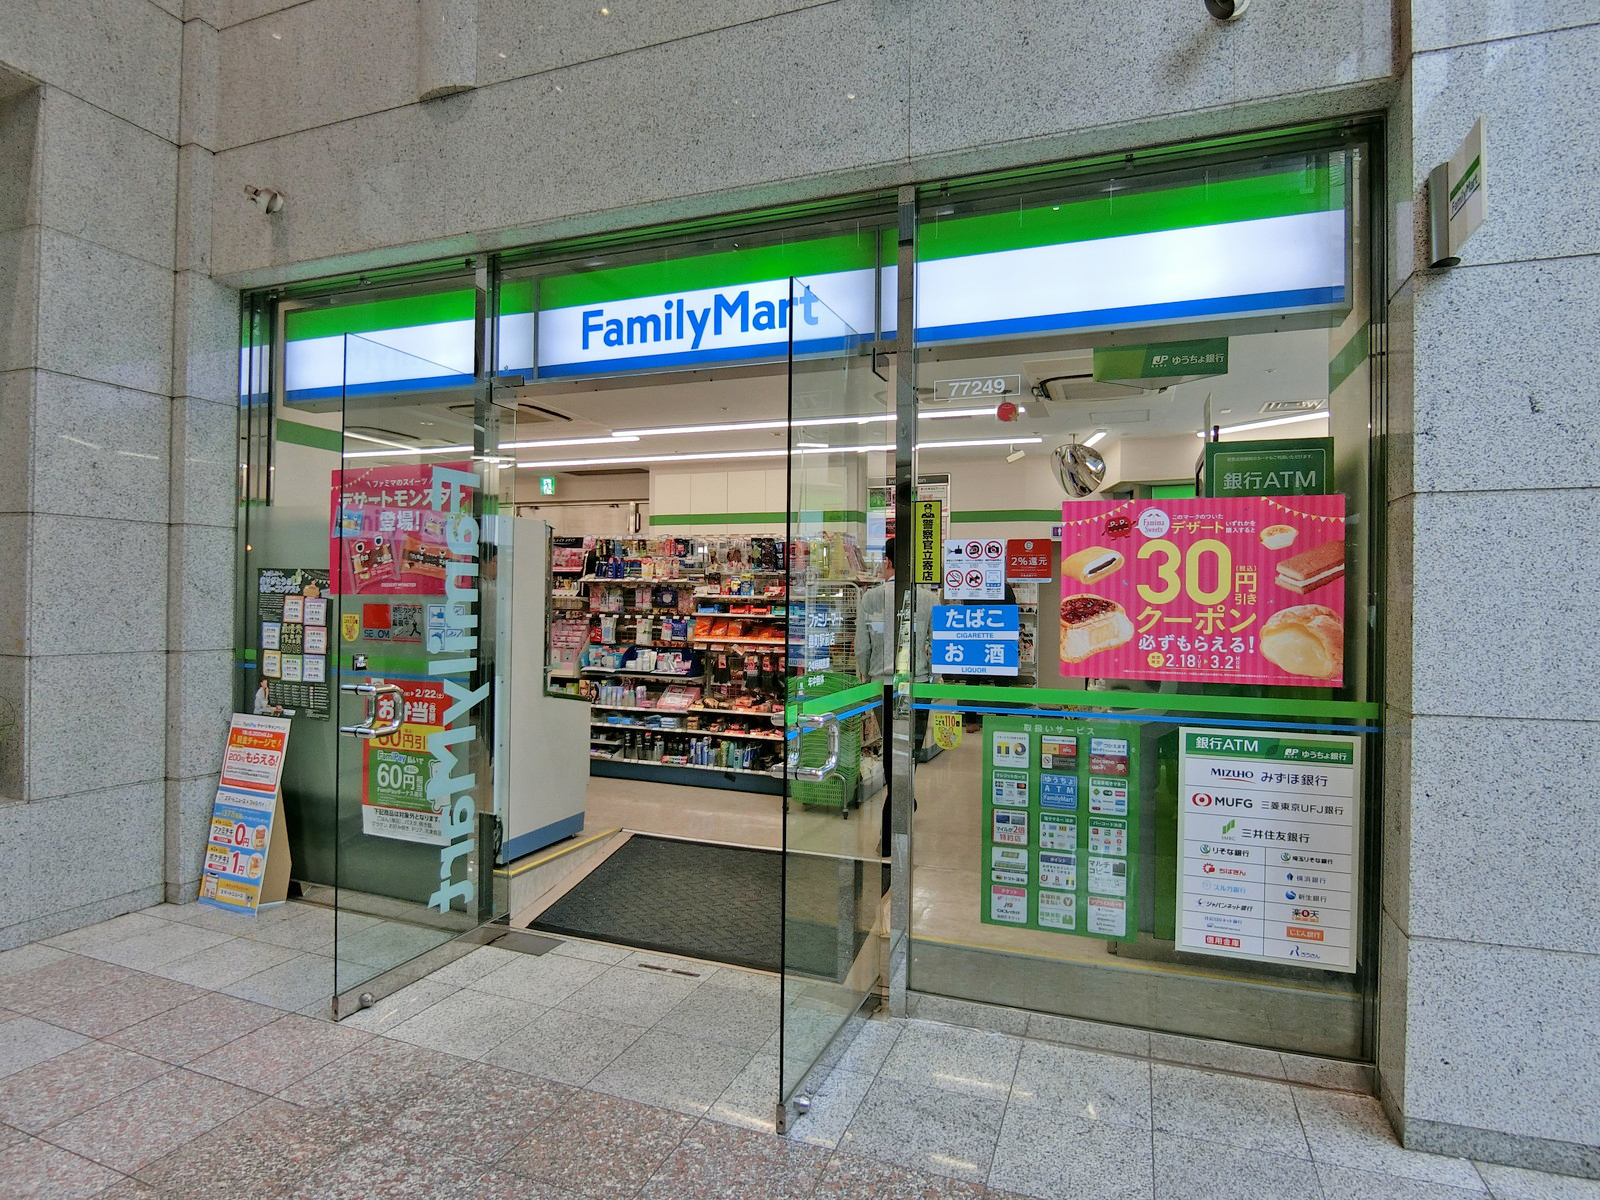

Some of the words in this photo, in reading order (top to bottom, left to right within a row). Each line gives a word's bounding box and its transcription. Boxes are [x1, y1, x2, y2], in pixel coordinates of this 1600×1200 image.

[582, 285, 819, 351] FamilyMart
[1172, 353, 1224, 365] ゆうちょ銀行
[949, 379, 1005, 397] 77249
[373, 479, 428, 488] ファミマのスイーツ
[1223, 471, 1316, 490] 銀行ATM
[339, 488, 466, 510] デザートモンスタ
[380, 510, 420, 532] 登場!
[1171, 521, 1224, 535] デザート
[922, 519, 933, 581] 警察官立寄店
[1011, 557, 1048, 566] 2%還元
[1137, 539, 1232, 605] 30
[808, 613, 843, 628] ファミリーマート
[945, 608, 1004, 628] たばこ
[1137, 605, 1257, 635] クーポン
[364, 630, 390, 638] SEOM
[1138, 634, 1255, 653] 必ずもらえる!
[1166, 654, 1196, 668] 2.18
[1211, 655, 1234, 669] 3.2
[415, 689, 436, 698] 2/22
[1023, 723, 1095, 736] 取扱いサービス
[1195, 736, 1259, 753] 銀行ATM
[377, 750, 406, 762] FamiPay
[1301, 751, 1347, 761] ゆうちょ銀行
[1211, 768, 1254, 779] MIZUHO
[1261, 772, 1328, 787] みずほ銀行
[1043, 775, 1074, 785] ゆうちょ
[1043, 794, 1075, 804] FamilyMart
[1215, 796, 1253, 808] MUFG
[1261, 801, 1344, 816] 三菱東京UFJ銀行
[1241, 828, 1310, 844] 三井住友銀行
[1212, 846, 1250, 858] りそな銀行
[1089, 860, 1111, 868] マルチ
[1292, 856, 1334, 865] 埼玉りそな銀行
[1089, 867, 1111, 875] コピー
[1219, 868, 1246, 876] ちばぎん
[1296, 875, 1327, 885] 横浜銀行
[1214, 884, 1246, 894] スルガ銀行
[1298, 893, 1327, 903] 新生銀行
[1206, 900, 1253, 912] ジャパンネット銀行
[1289, 929, 1321, 939] じぶん銀行
[1206, 936, 1240, 946] 信用金庫
